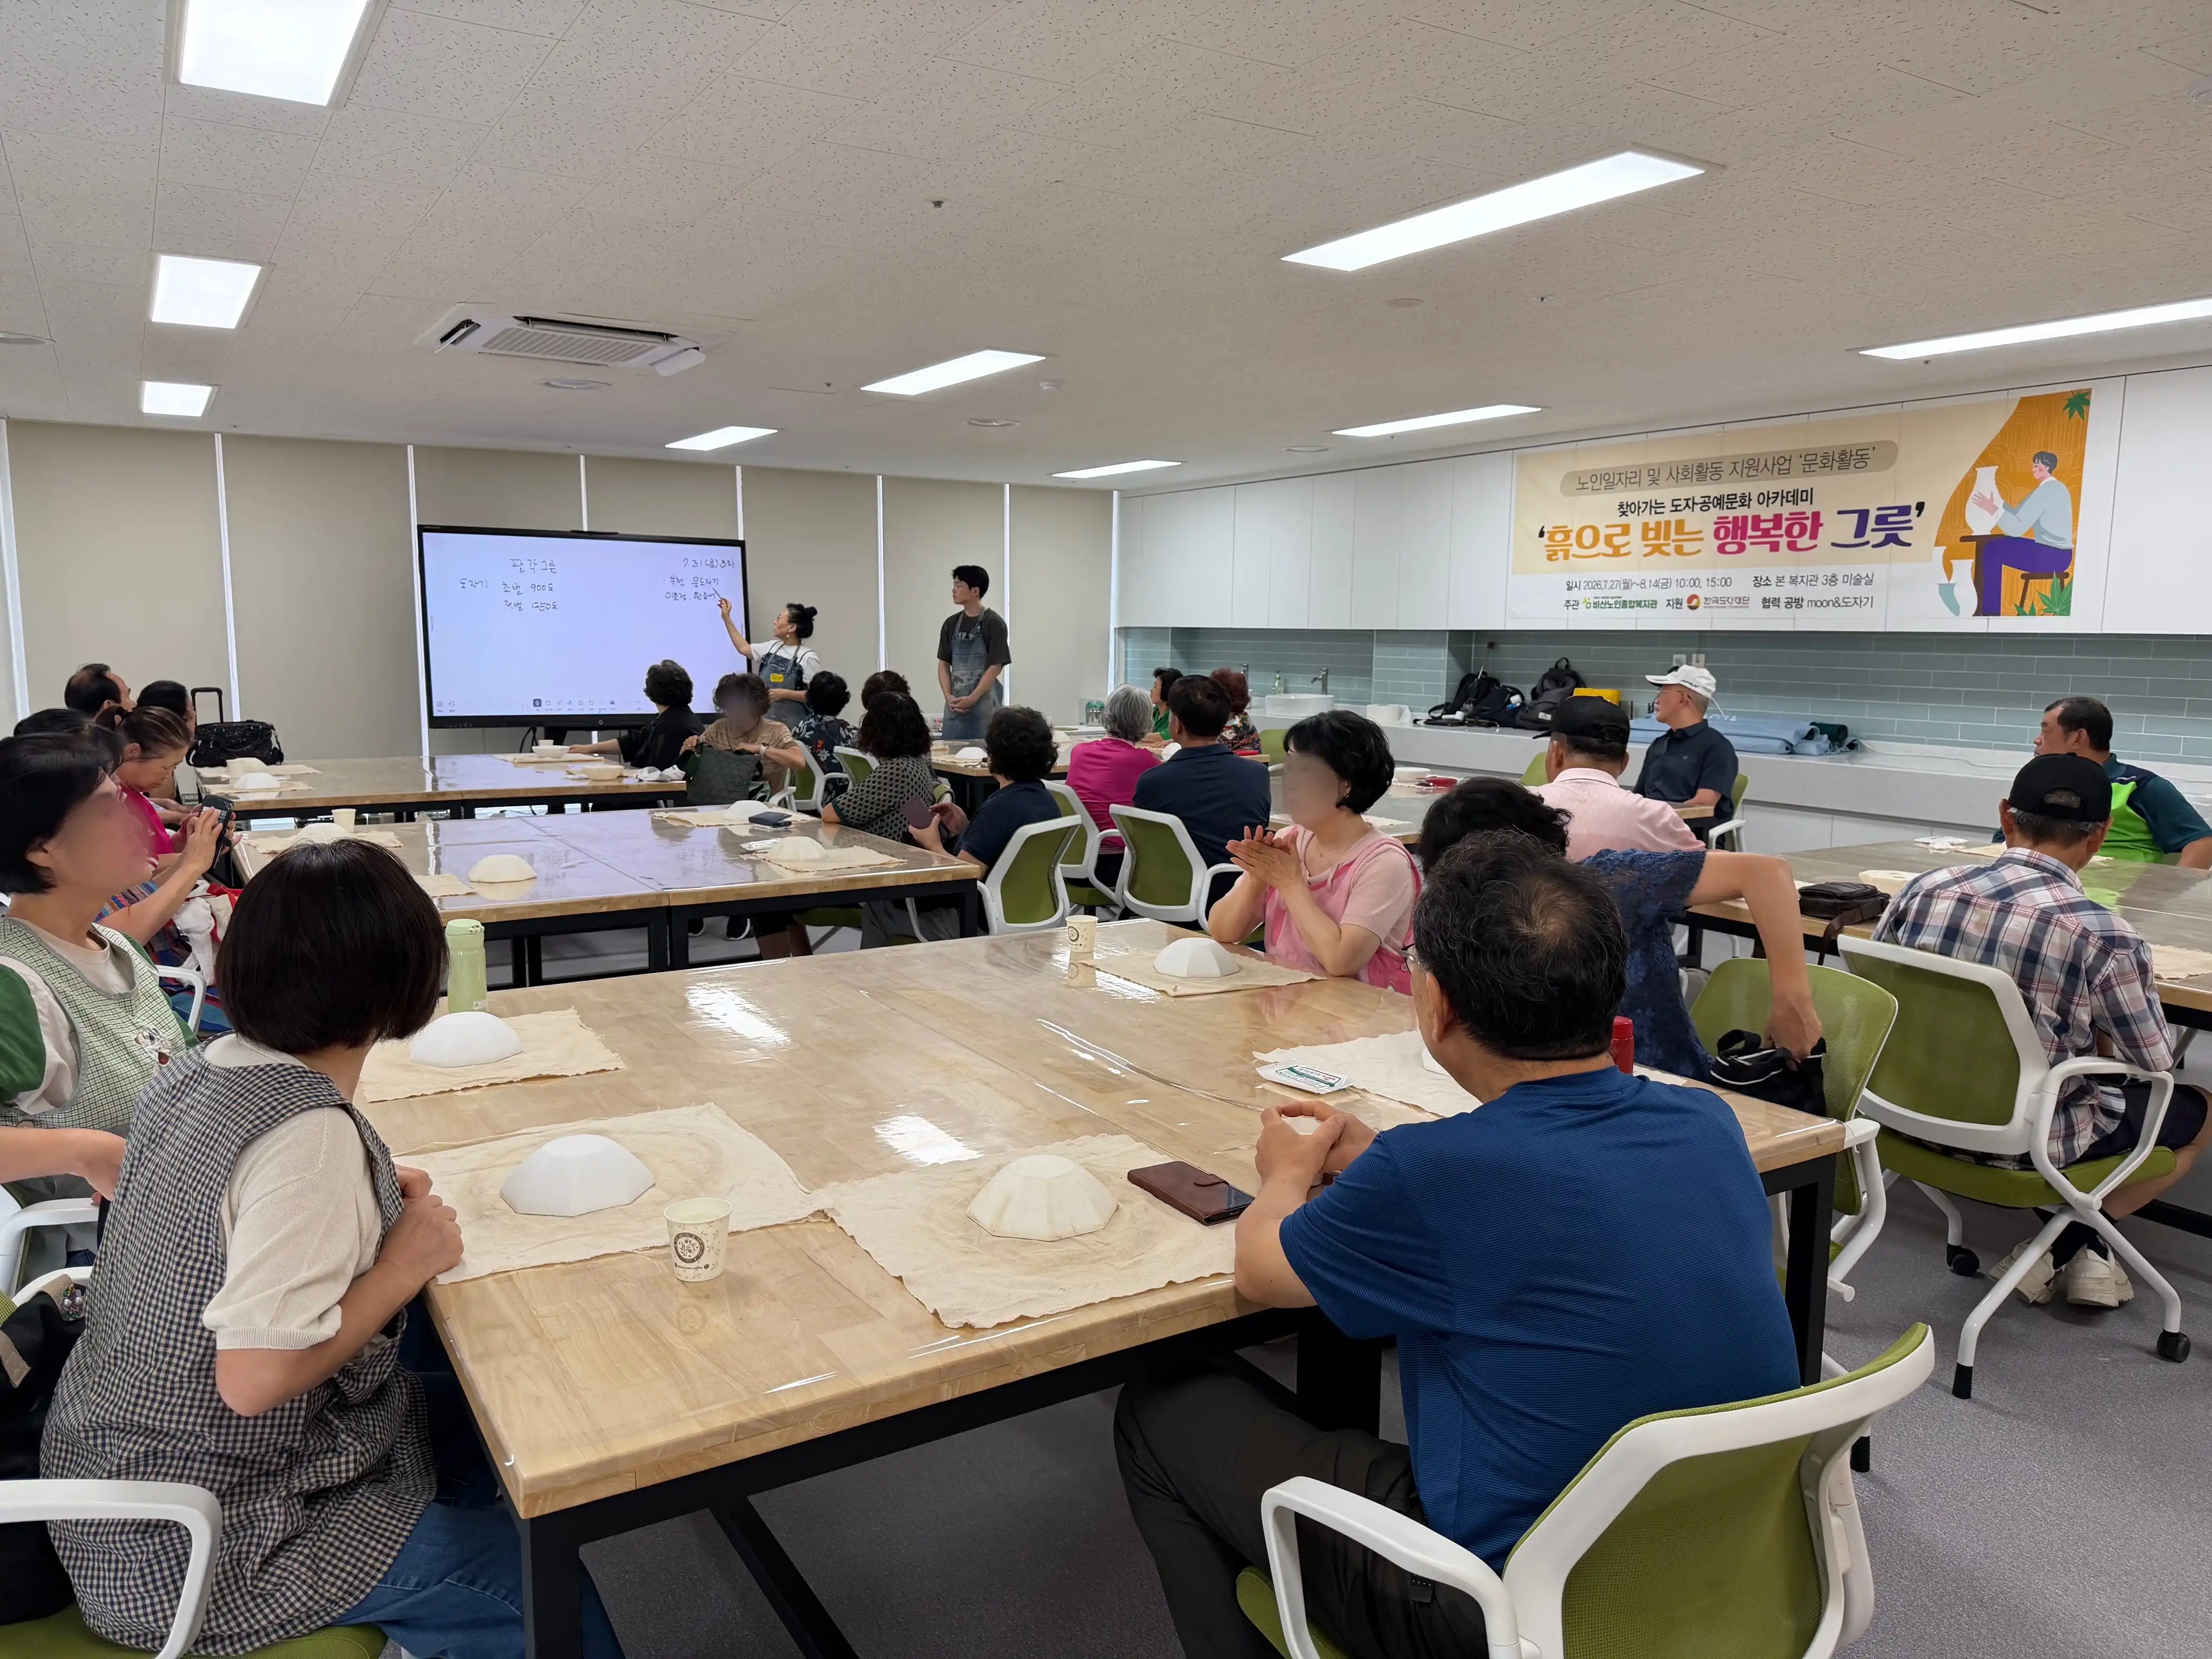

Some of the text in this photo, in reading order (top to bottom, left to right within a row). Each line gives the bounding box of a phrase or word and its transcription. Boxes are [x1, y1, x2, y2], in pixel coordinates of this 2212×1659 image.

[1575, 469, 1642, 491] 노인일자리
[1647, 467, 1661, 486] 및
[1665, 461, 1725, 484] 사회활동
[1729, 454, 1792, 478] 지원사업
[1617, 498, 1666, 517] 찾아가는
[1757, 487, 1814, 508] 아카데미
[1641, 518, 1704, 557] 빚는
[1713, 510, 1824, 555] 행복한
[1566, 579, 1581, 591] 일시
[1707, 577, 1732, 588] 15:00
[1752, 575, 1772, 588] 장소
[1775, 575, 1785, 587] 본
[1788, 574, 1819, 587] 복지관
[1821, 573, 1839, 586] 3층
[1842, 572, 1874, 586] 미술실
[1563, 599, 1580, 611] 주관
[1665, 598, 1683, 610] 지원
[1761, 596, 1781, 610] 협력
[1783, 596, 1804, 610] 공방
[1806, 595, 1874, 609] moon&도자기
